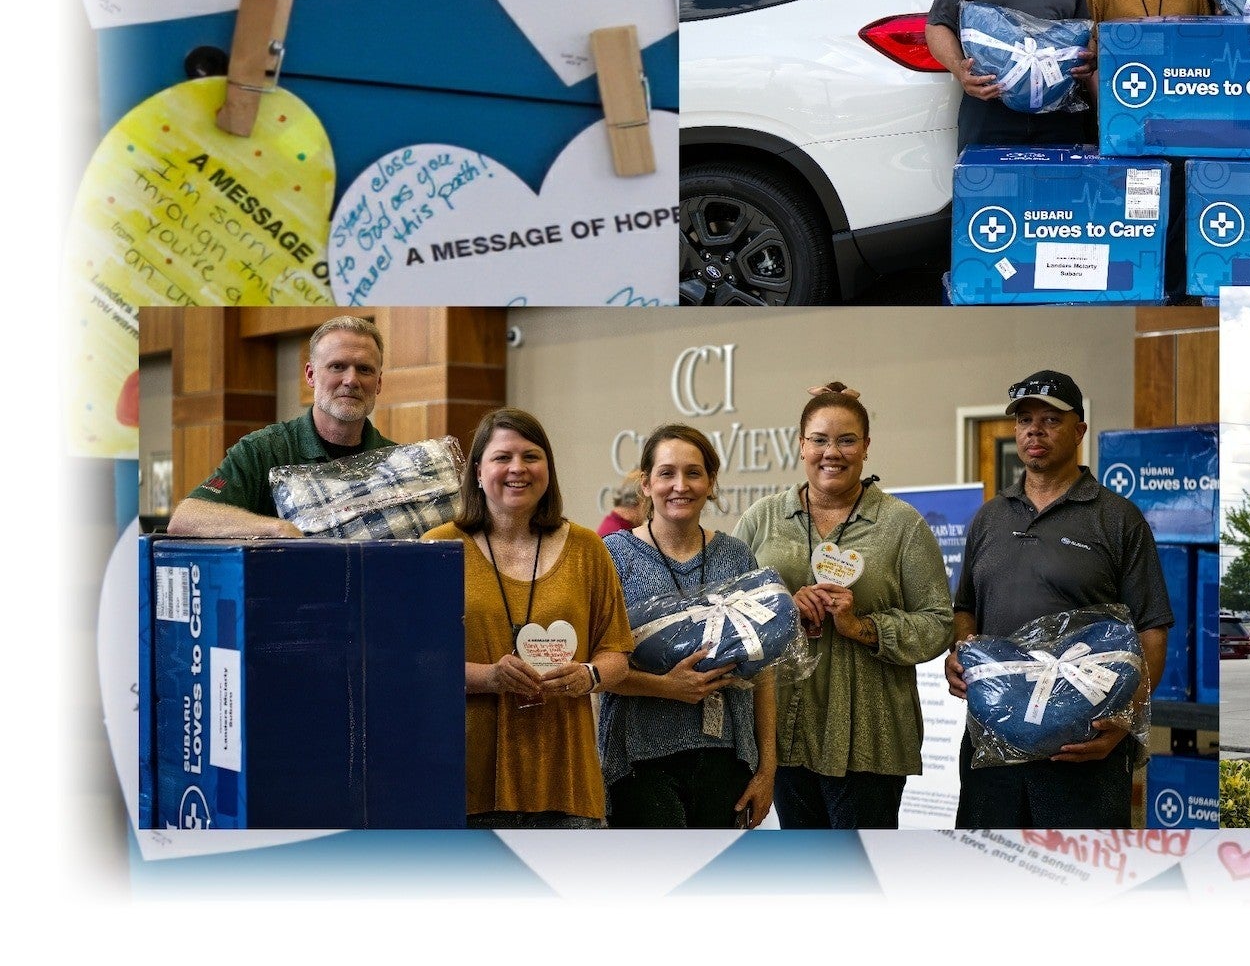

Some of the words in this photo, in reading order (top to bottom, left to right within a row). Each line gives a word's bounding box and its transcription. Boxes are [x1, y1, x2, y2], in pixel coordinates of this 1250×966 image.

[1163, 68, 1211, 78] SUBARU
[1164, 79, 1220, 96] Loves
[1224, 80, 1242, 96] to
[188, 153, 209, 173] A
[208, 169, 314, 264] MESSAGE
[1024, 210, 1072, 220] SUBARU
[1024, 222, 1082, 238] Loves
[1087, 222, 1106, 238] to
[1109, 221, 1155, 238] Care
[406, 247, 424, 267] A
[432, 225, 563, 263] MESSAGE
[571, 218, 605, 240] OF
[1140, 467, 1174, 476] SUBARU
[1140, 477, 1180, 490] Loves
[1184, 476, 1197, 490] to
[190, 564, 202, 638] Care
[190, 644, 202, 676] to
[184, 695, 192, 772] SUBARU
[190, 682, 202, 774] Loves
